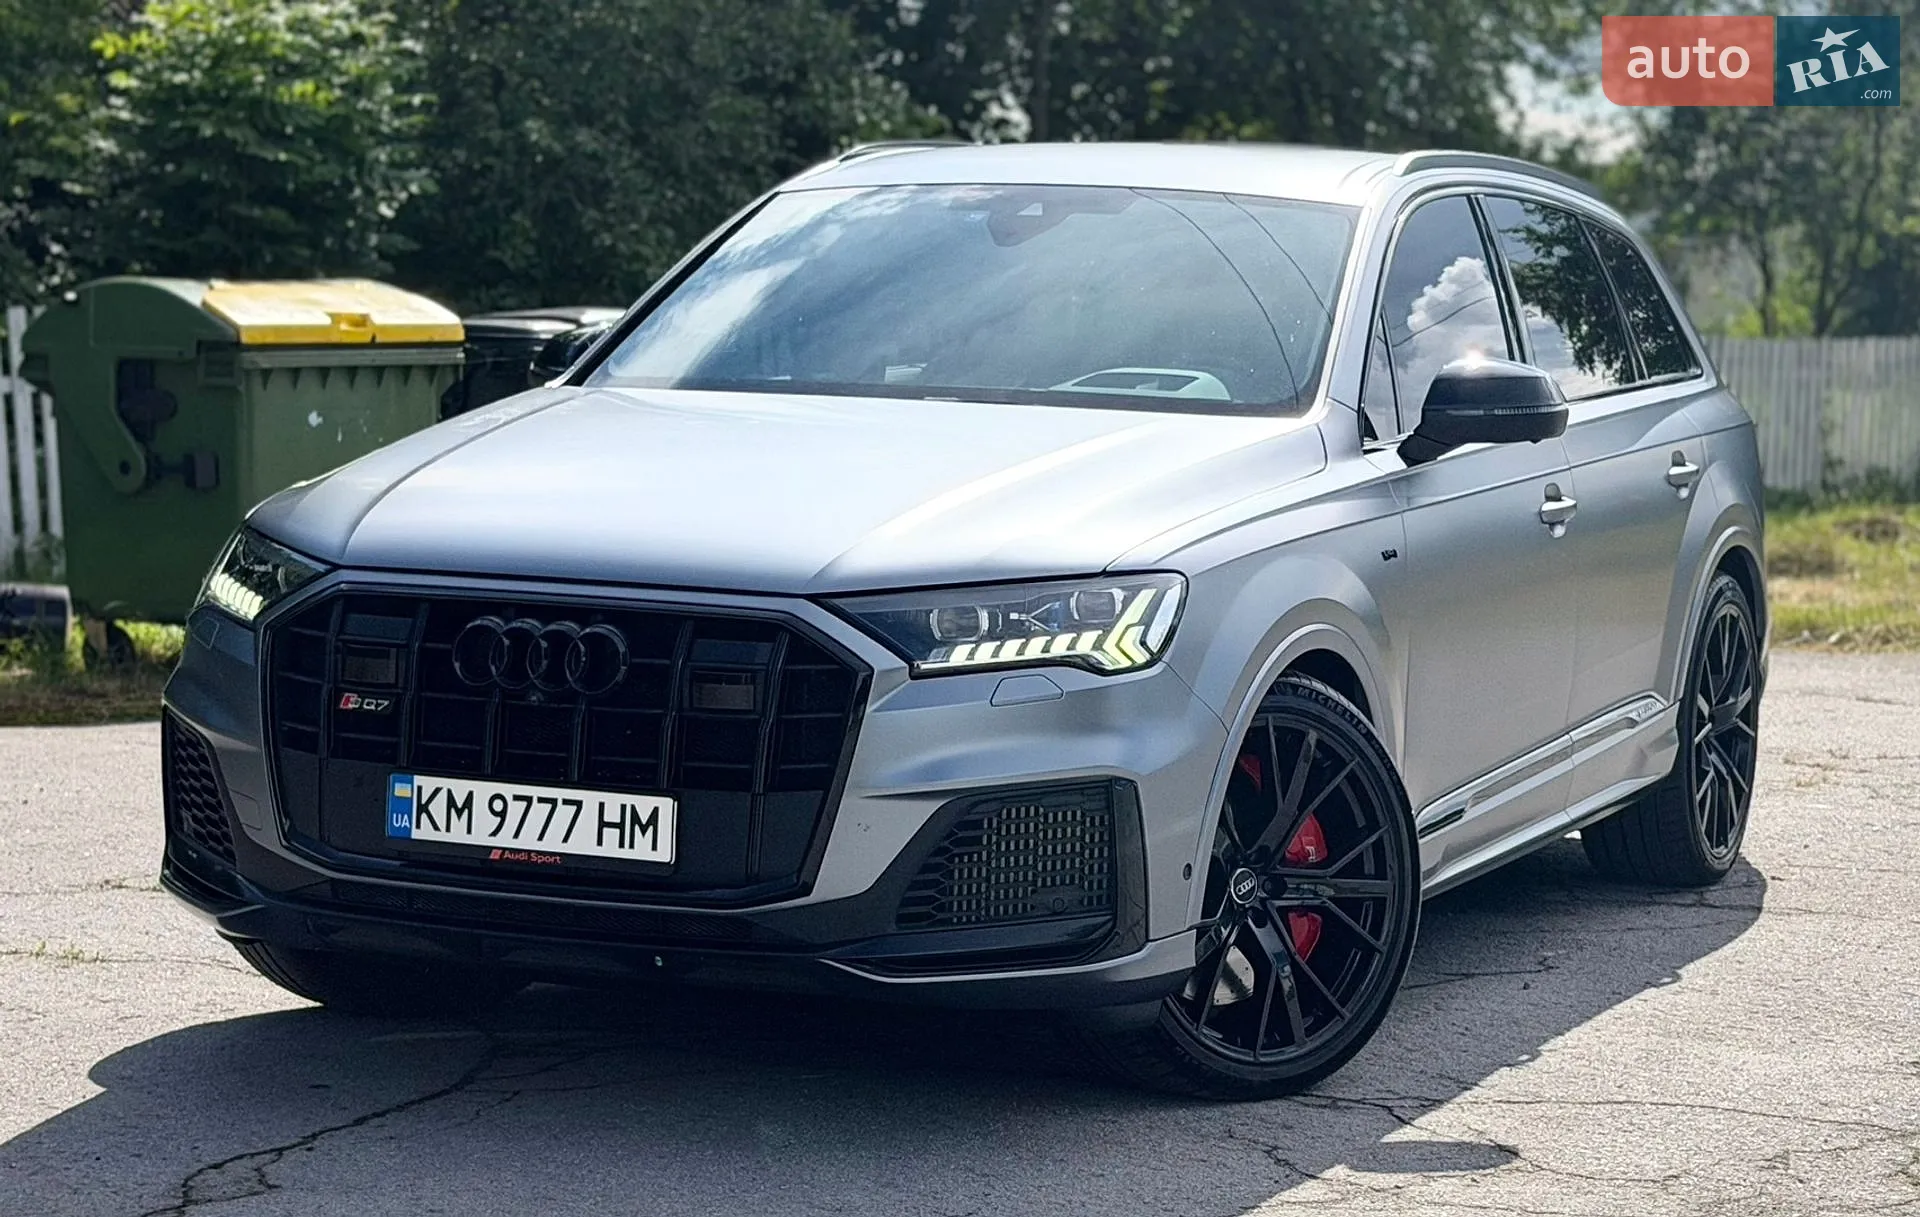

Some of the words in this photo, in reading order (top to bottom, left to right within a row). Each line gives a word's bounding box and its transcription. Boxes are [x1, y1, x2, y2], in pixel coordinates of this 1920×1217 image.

[393, 813, 411, 829] UA
[415, 785, 474, 835] KM
[488, 793, 584, 844] 9777
[596, 801, 660, 852] HM
[503, 850, 529, 861] Audi
[530, 852, 561, 864] Sport
